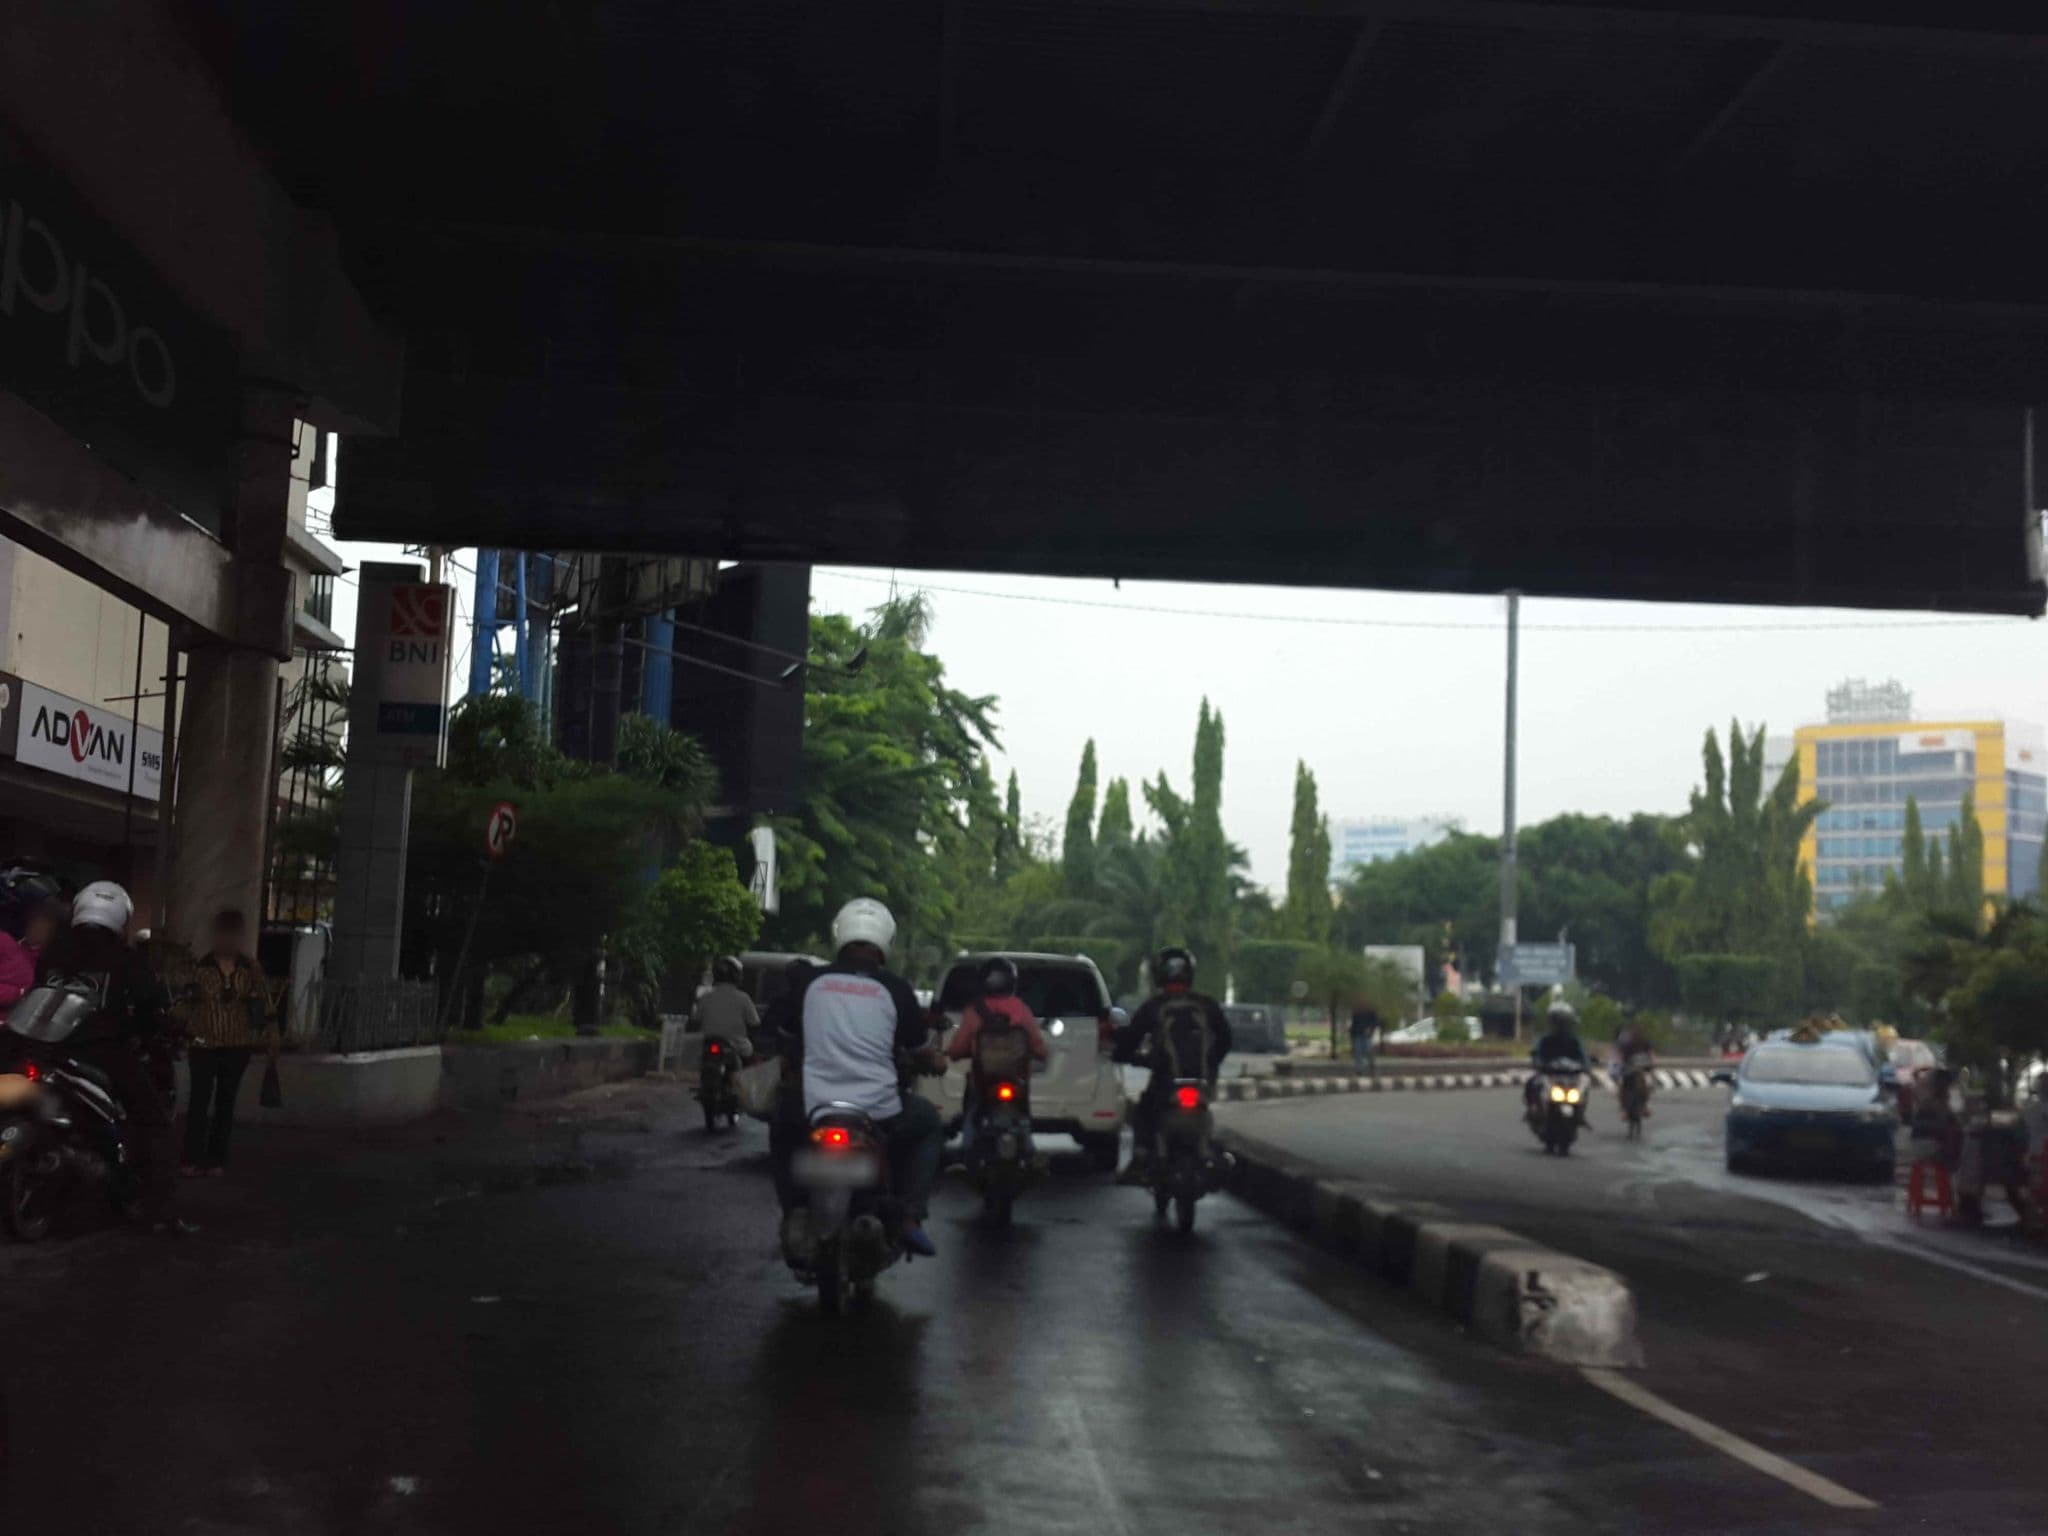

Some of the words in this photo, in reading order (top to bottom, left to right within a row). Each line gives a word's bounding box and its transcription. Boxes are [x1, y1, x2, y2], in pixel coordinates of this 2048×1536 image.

[0, 198, 175, 408] ppo
[389, 640, 437, 664] BNI
[31, 705, 124, 765] ADVAN
